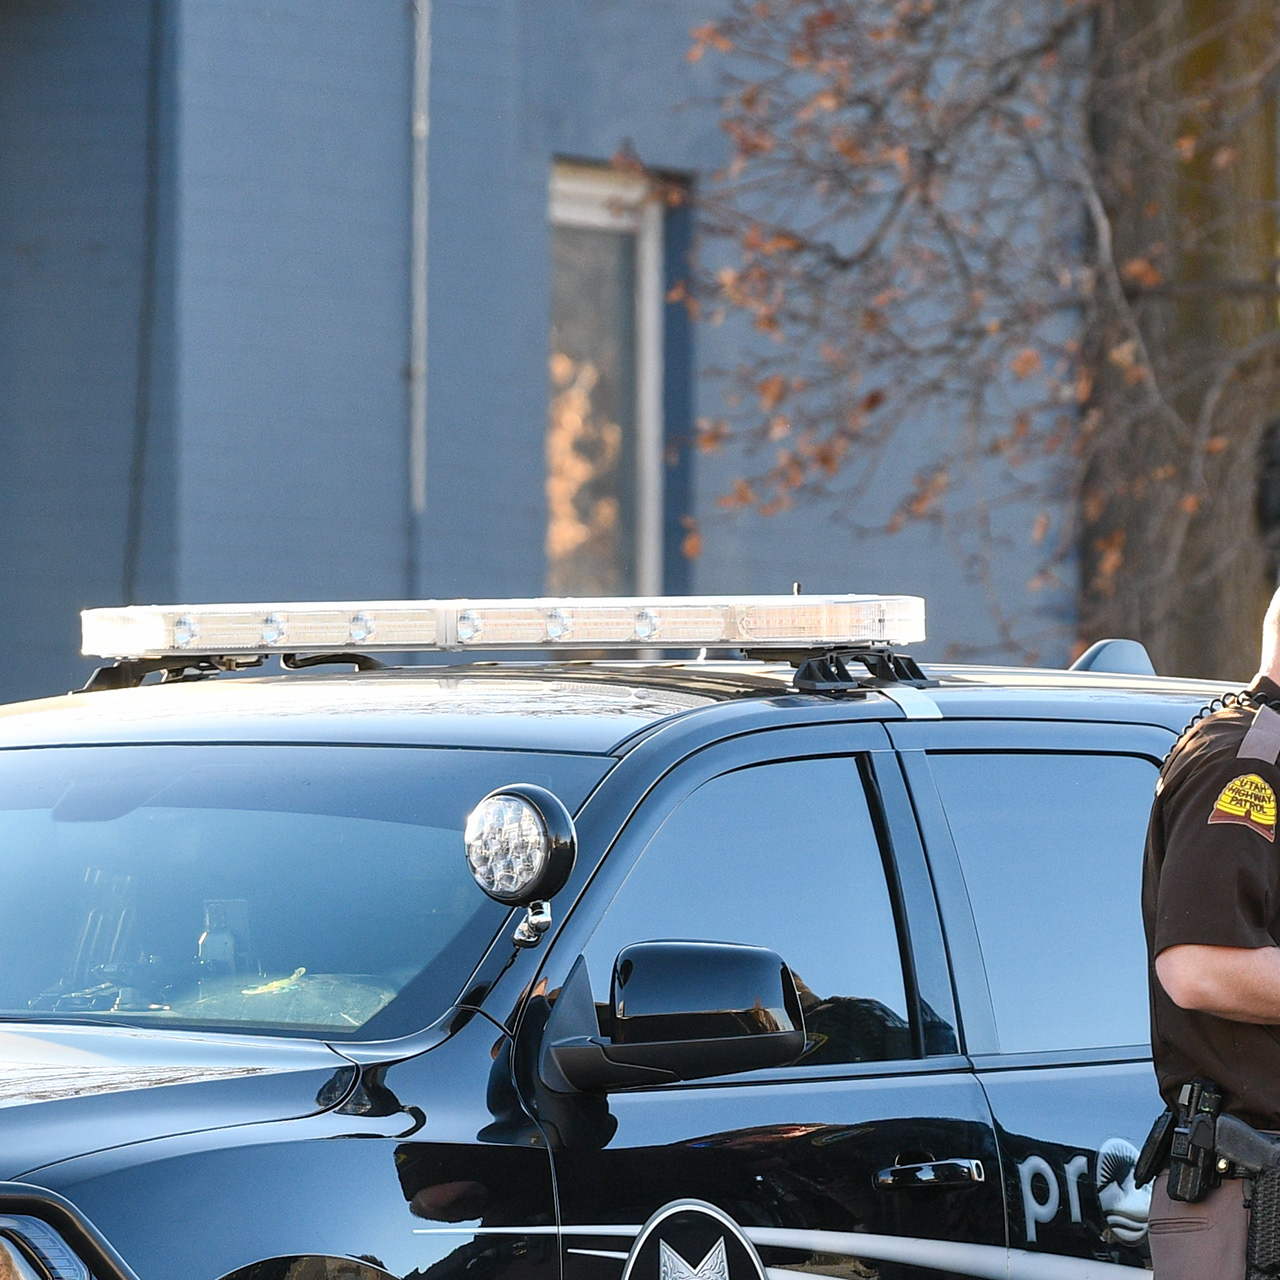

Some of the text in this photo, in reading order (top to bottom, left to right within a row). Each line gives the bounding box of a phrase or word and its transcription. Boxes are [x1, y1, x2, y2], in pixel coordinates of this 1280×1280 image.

[1228, 785, 1272, 804] HIGHWAY
[1239, 778, 1268, 793] UTAH
[1229, 796, 1268, 814] PATROL
